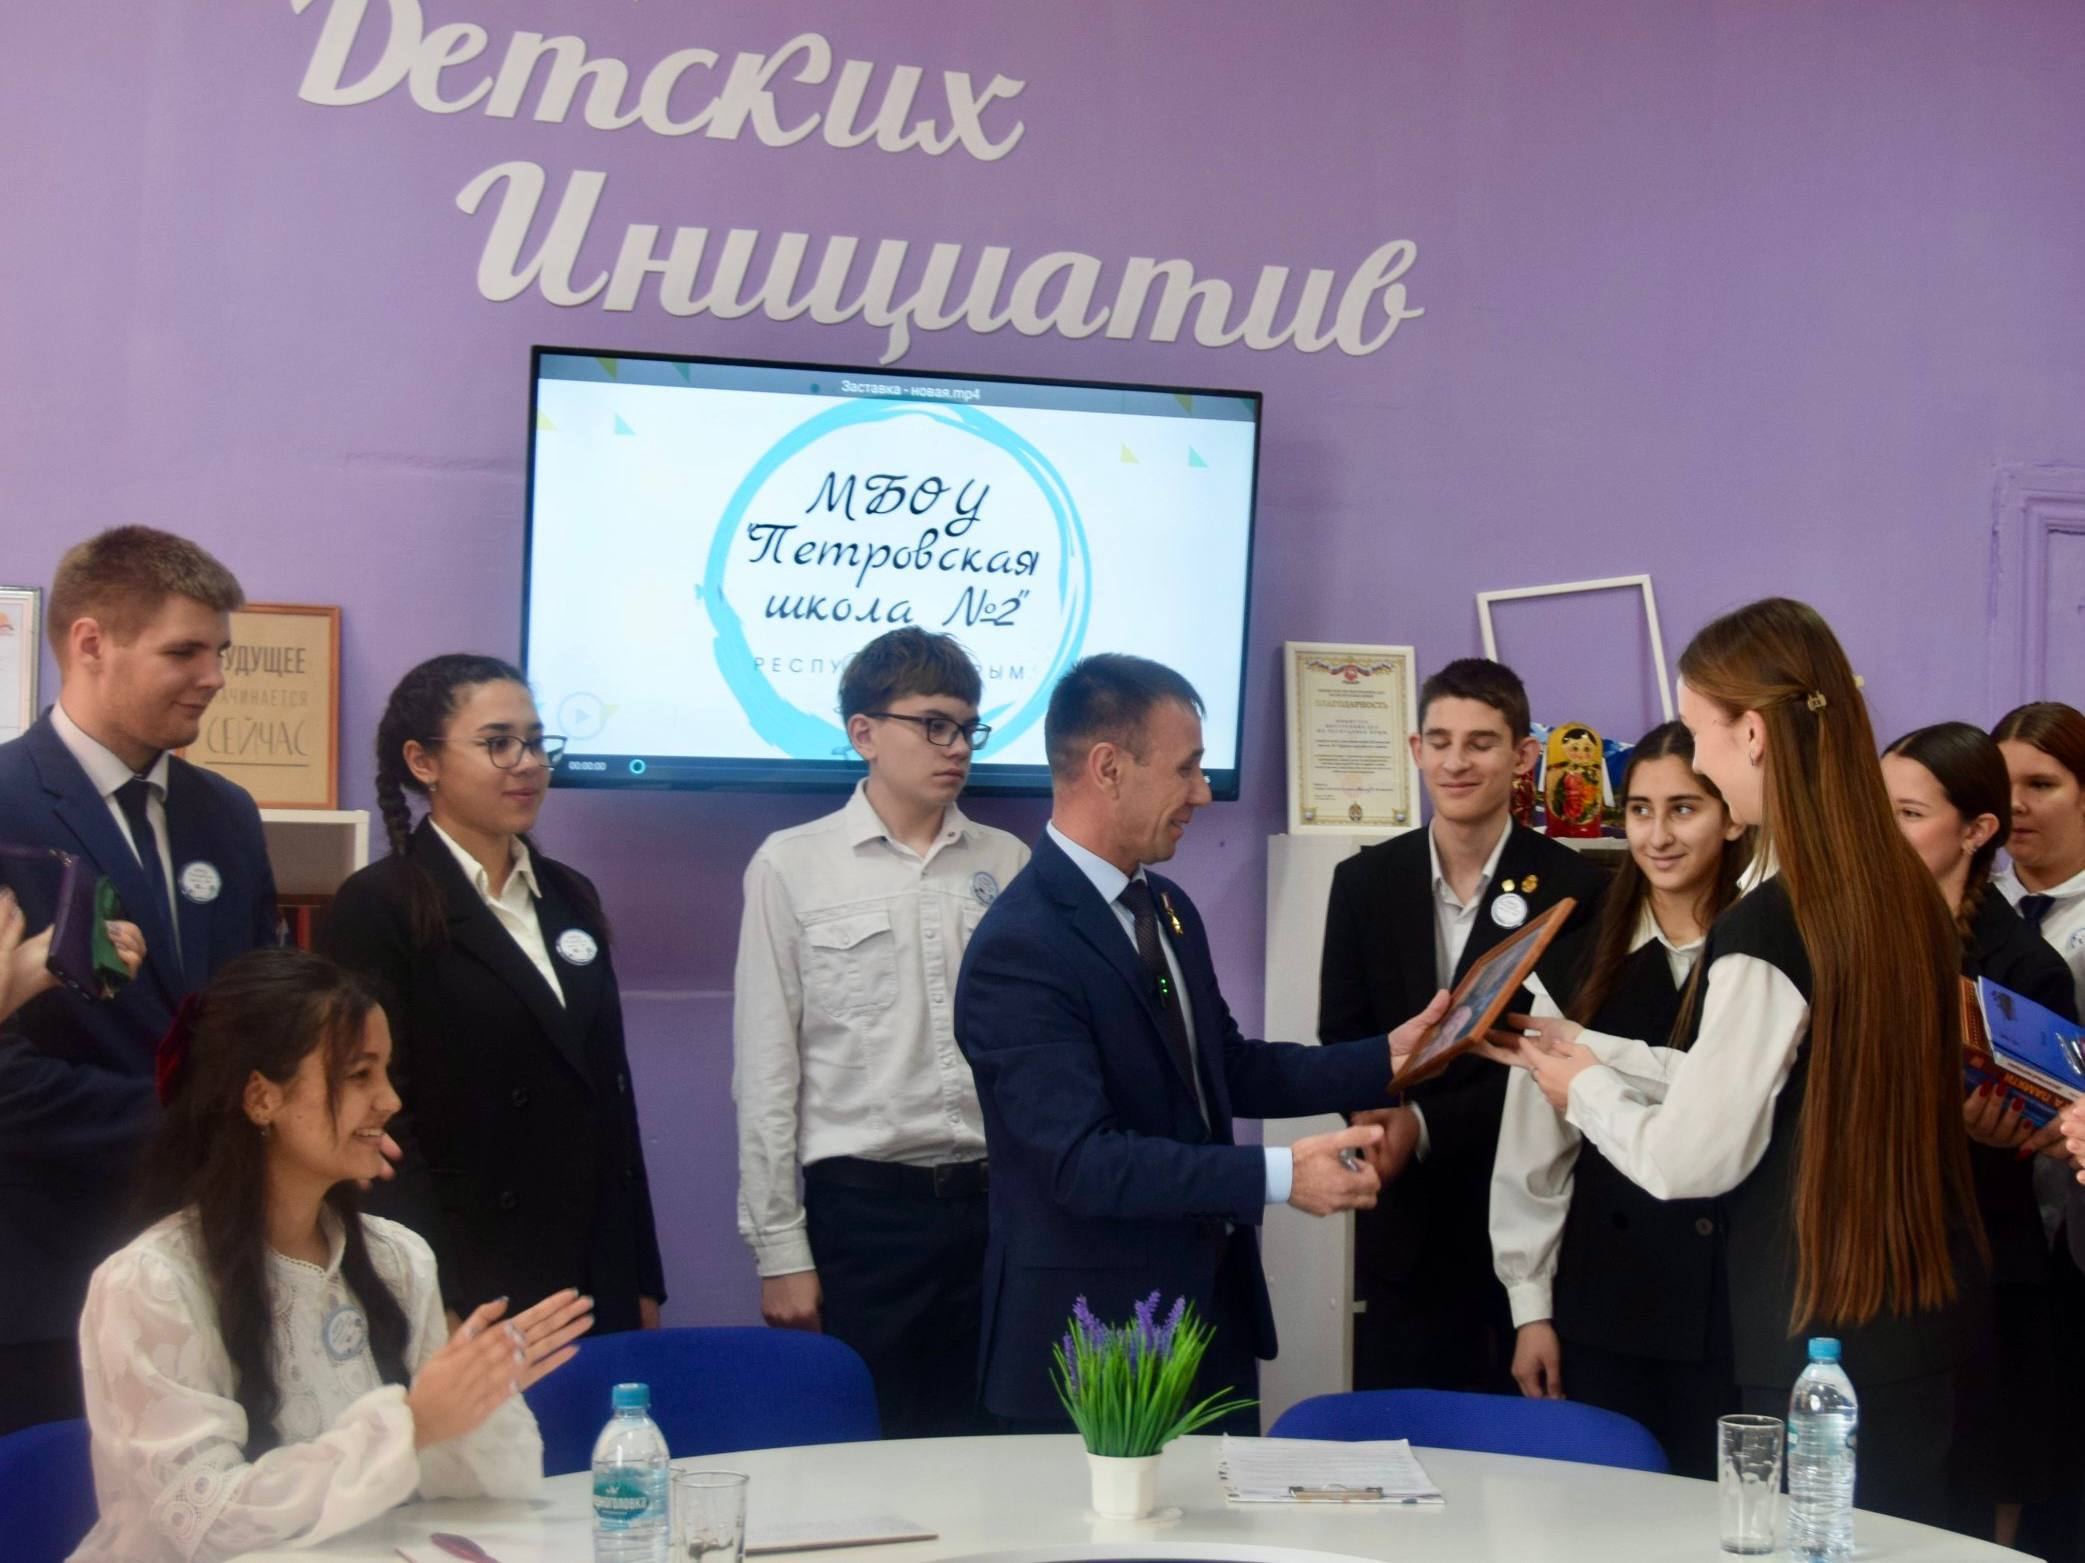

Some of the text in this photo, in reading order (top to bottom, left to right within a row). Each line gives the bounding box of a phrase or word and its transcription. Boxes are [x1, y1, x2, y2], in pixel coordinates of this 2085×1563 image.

[290, 0, 1026, 161] Детских
[455, 160, 1425, 365] Инициатив
[841, 379, 901, 395] Заставка
[911, 386, 981, 402] новая.mp4
[805, 471, 991, 537] МБОУ
[764, 595, 914, 624] школа
[224, 645, 307, 678] УДУЩЕЕ
[754, 656, 842, 674] РЕСПУ
[216, 688, 309, 708] АЧИНАЕТСЯ
[207, 715, 309, 757] СЕЙЧАС
